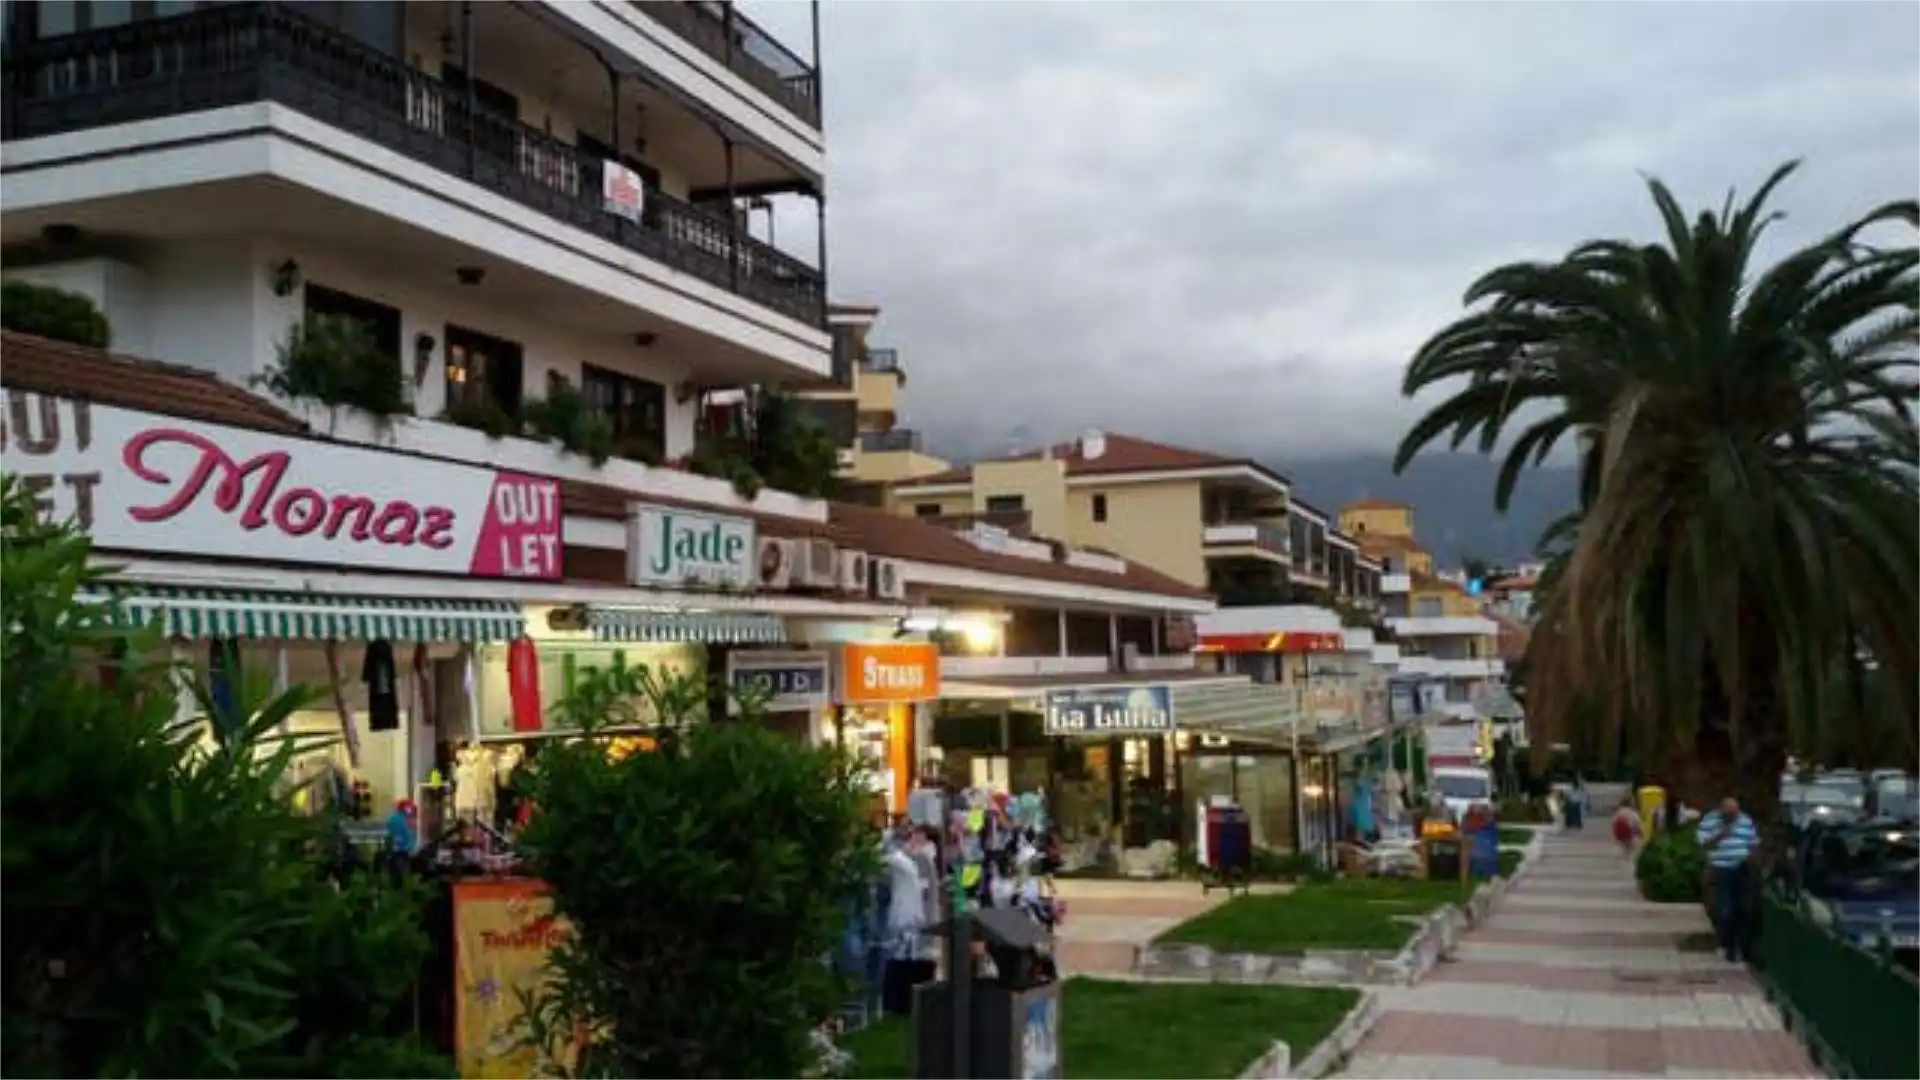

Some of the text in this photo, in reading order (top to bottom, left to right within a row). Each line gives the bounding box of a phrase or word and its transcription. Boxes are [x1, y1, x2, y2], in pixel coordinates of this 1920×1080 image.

[122, 428, 457, 549] Monaz
[496, 482, 556, 526] OUT
[501, 533, 557, 576] LET
[651, 512, 744, 575] Jade
